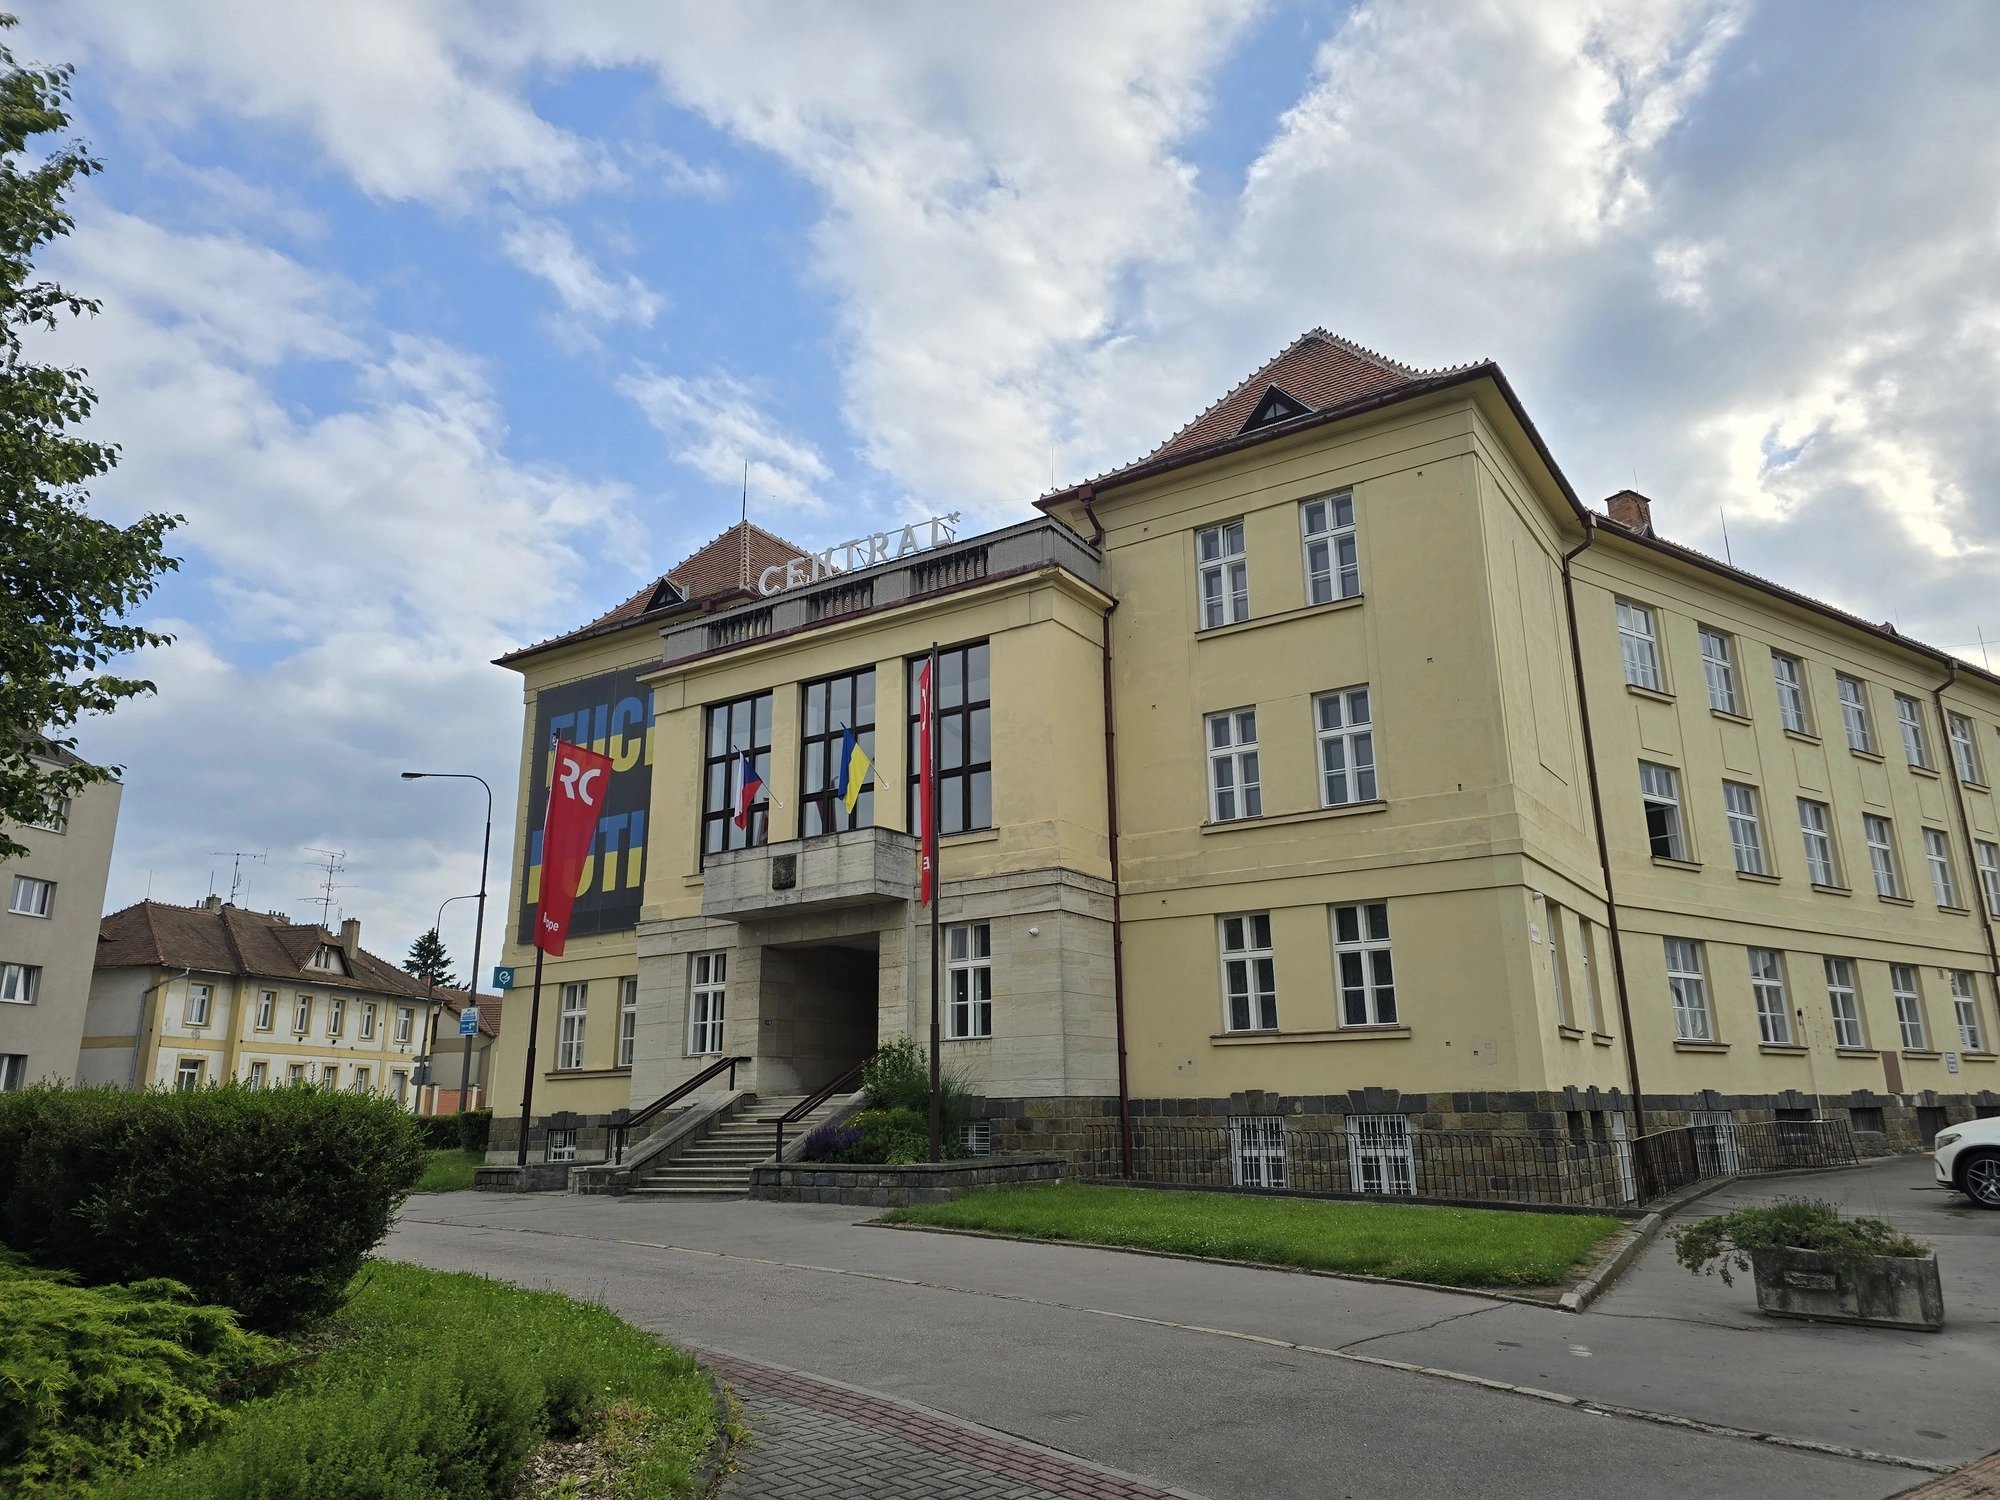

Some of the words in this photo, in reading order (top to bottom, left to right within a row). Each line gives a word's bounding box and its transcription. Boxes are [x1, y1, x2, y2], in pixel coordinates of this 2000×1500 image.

[758, 516, 950, 597] CENTRAL
[559, 757, 602, 806] RC
[527, 809, 645, 904] UTI
